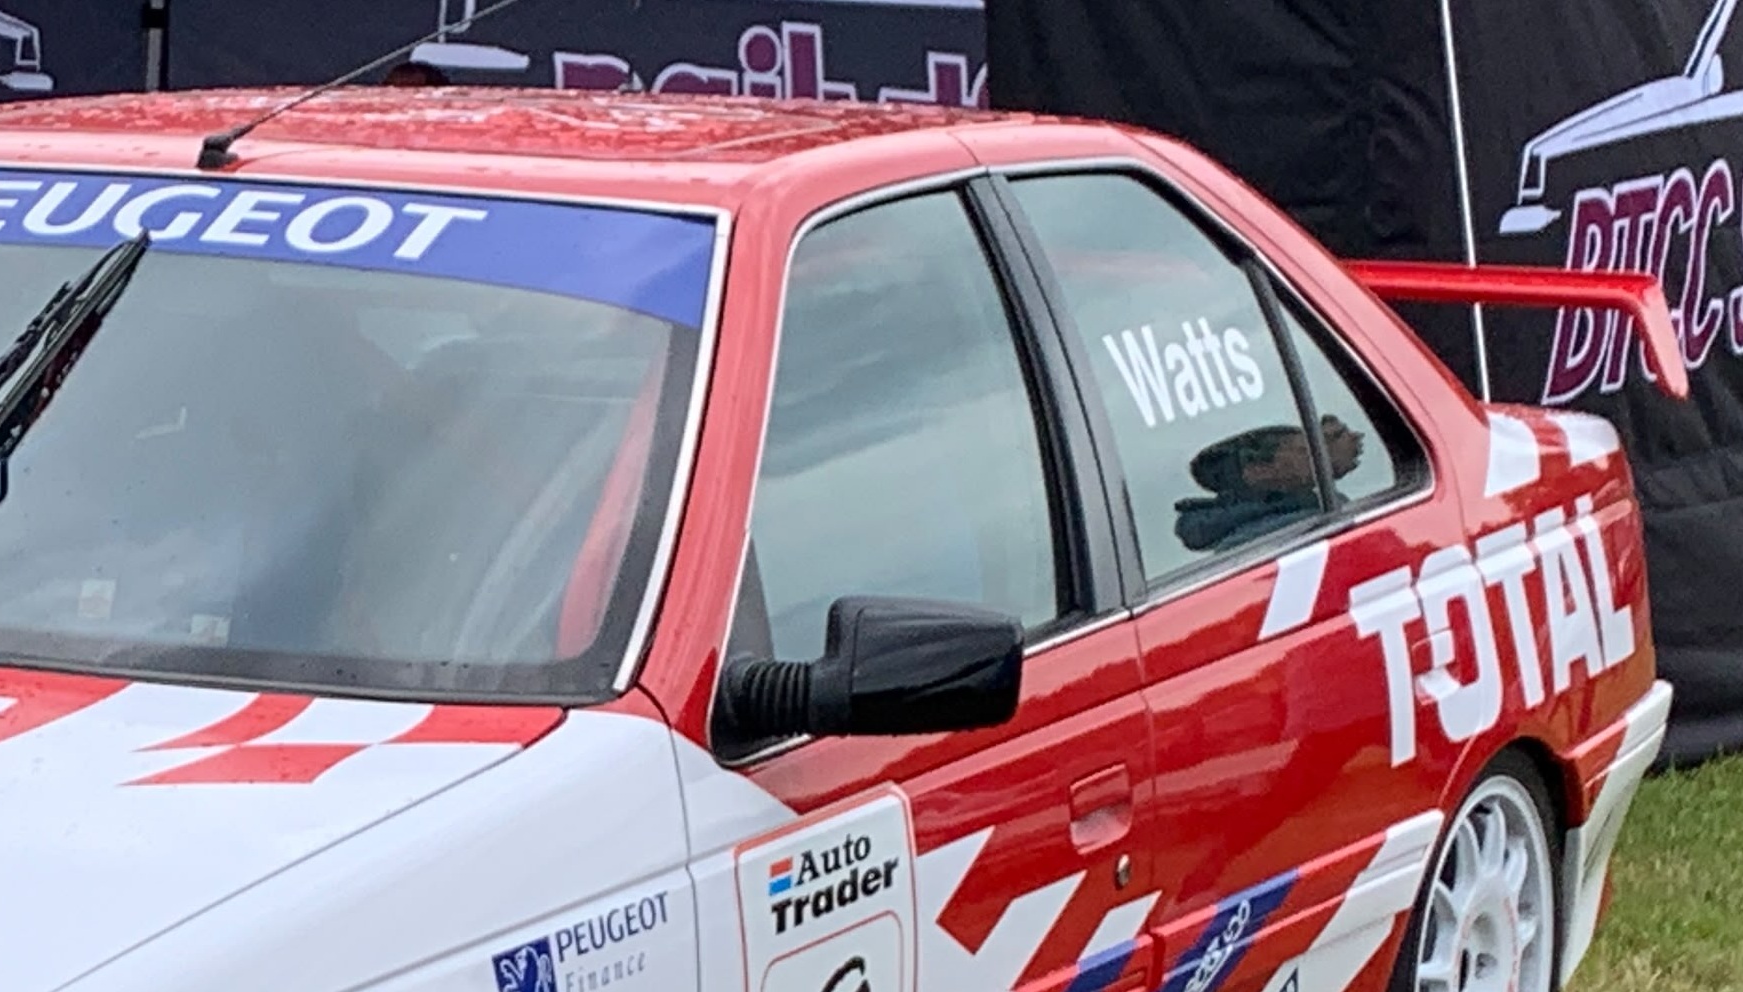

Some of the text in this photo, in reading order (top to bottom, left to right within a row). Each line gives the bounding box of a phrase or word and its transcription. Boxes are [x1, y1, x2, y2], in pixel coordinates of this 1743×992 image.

[1102, 317, 1264, 428] Watts
[1349, 494, 1635, 768] TOTAL
[771, 857, 899, 935] Trader
[794, 833, 871, 887] Auto
[555, 891, 668, 963] PEUGEOT
